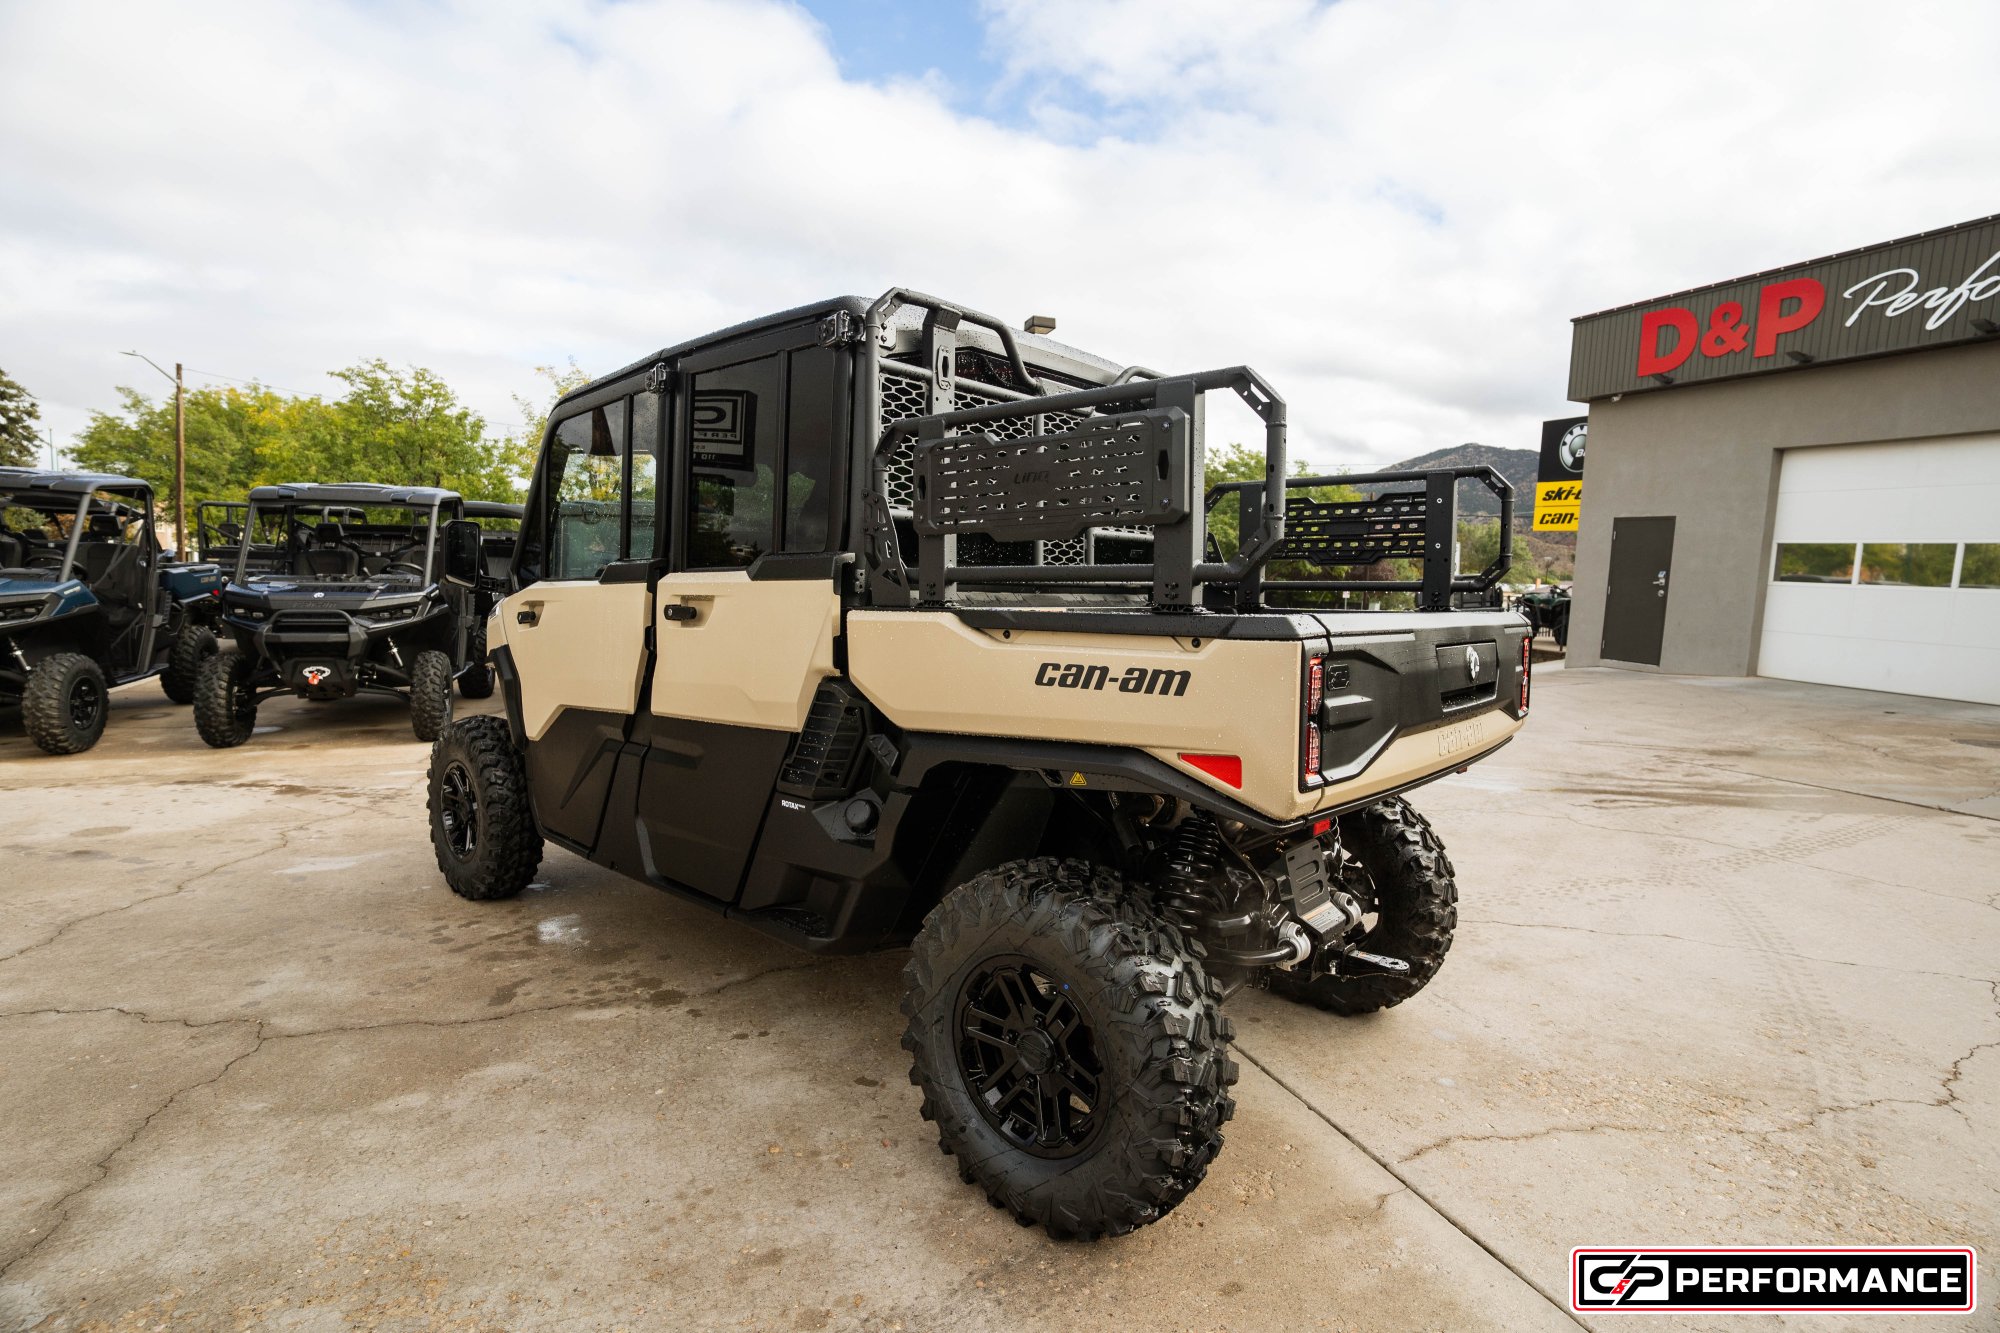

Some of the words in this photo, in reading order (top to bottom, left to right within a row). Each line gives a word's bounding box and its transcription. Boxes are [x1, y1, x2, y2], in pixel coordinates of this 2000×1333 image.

[1637, 277, 1825, 378] D&P
[1843, 250, 2000, 331] Perfo
[1034, 662, 1192, 697] can-am
